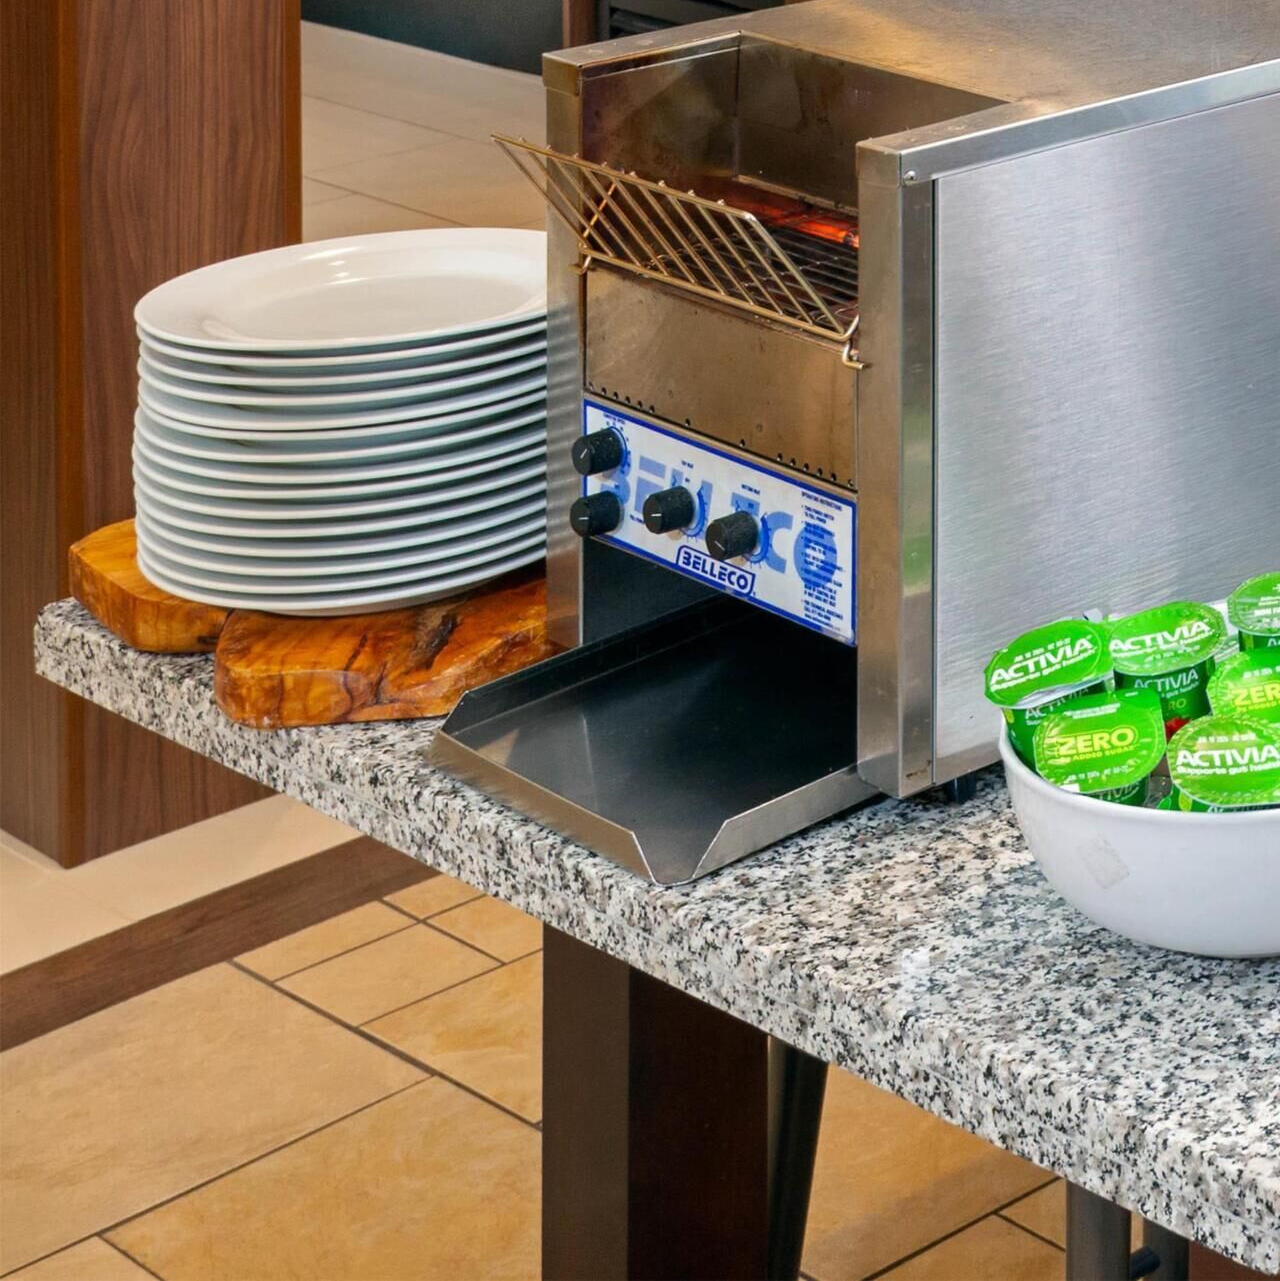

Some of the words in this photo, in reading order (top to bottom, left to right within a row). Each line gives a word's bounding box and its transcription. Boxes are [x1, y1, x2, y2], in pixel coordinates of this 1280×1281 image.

[682, 550, 749, 590] BELLECO
[1108, 621, 1211, 650] ACTIVIA
[990, 638, 1093, 685] ACTIVIA
[1056, 728, 1135, 756] ZERO
